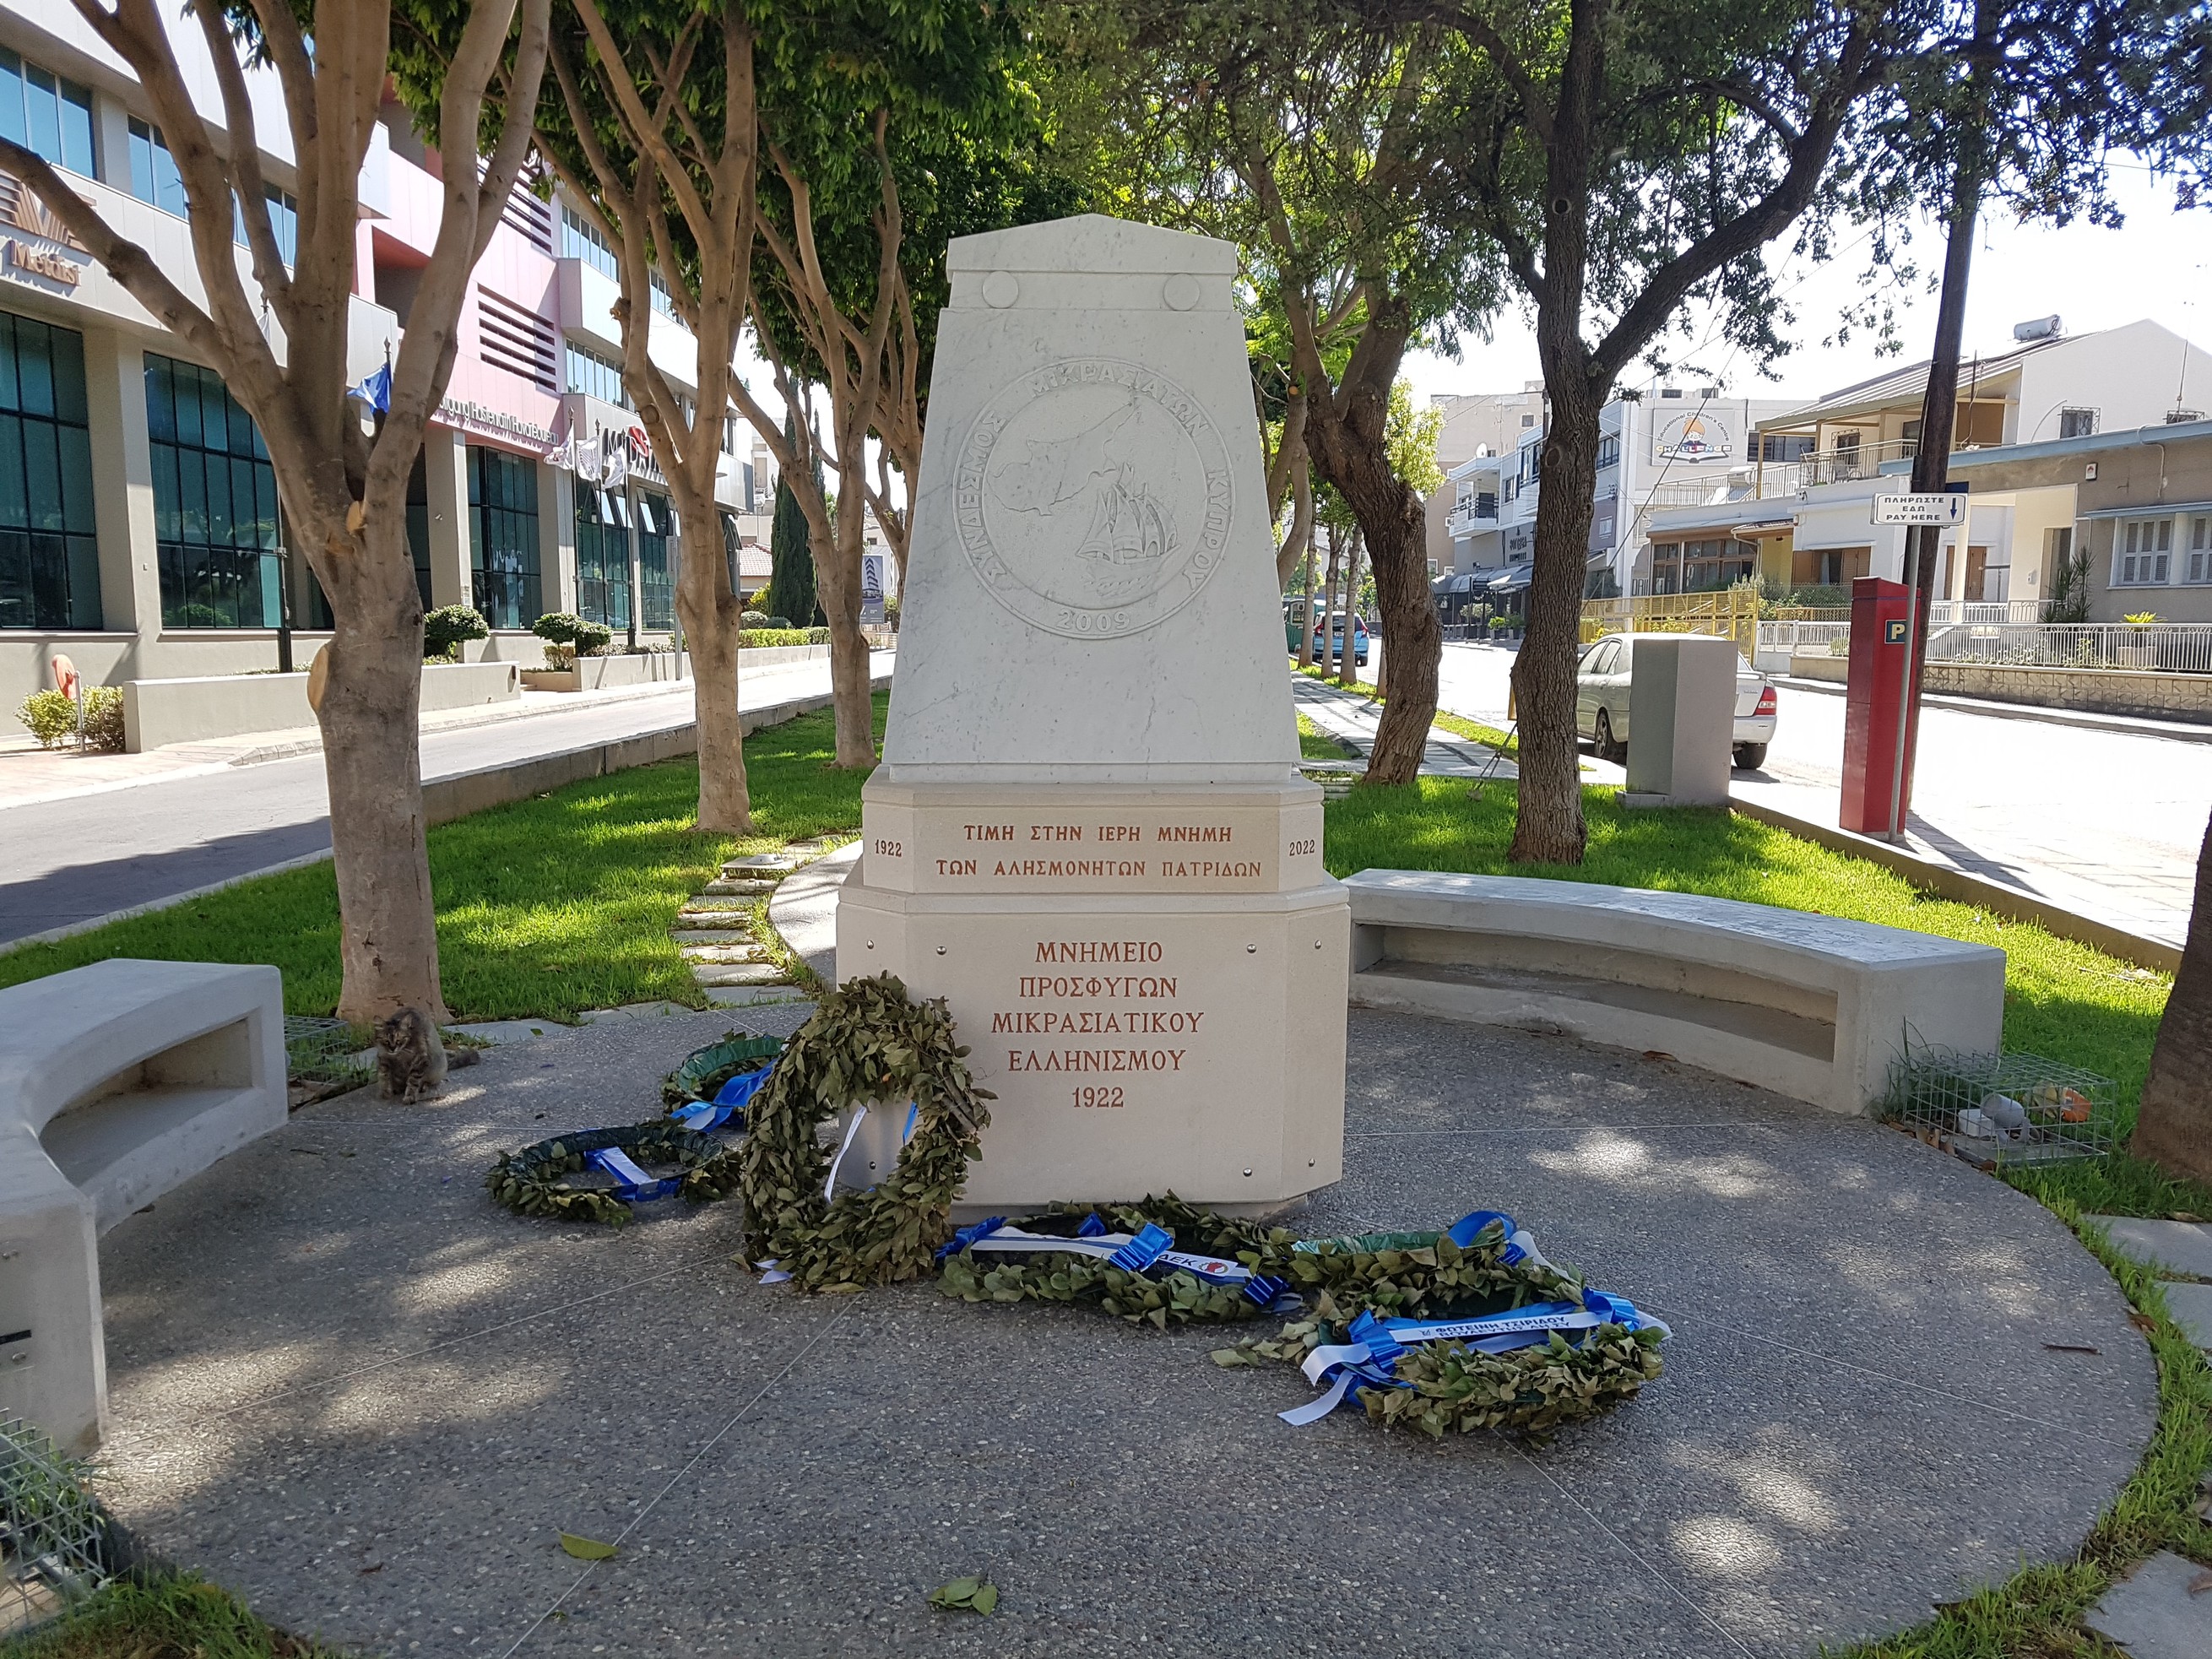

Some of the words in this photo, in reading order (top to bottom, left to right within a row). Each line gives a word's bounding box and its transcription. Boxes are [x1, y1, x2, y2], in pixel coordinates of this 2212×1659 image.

[10, 240, 81, 286] Metdist
[1024, 364, 1209, 437] ΜΙΚΡΑΣΙΑΤΩΝ
[1657, 413, 1685, 442] Educational
[1687, 412, 1717, 423] Chdren's
[1717, 422, 1729, 442] Centre
[1656, 444, 1732, 453] CHALLENGE
[959, 409, 1007, 584] ΣΥΝΔΕΣΜΟΣ
[1183, 469, 1230, 590] ΚΥΠΡΟΥ
[1056, 610, 1130, 633] 2009
[1891, 623, 1906, 639] P
[963, 825, 1014, 841] ΤΙΜΗ
[1030, 826, 1082, 841] ΣΤΗΝ
[1098, 826, 1141, 842] ΙΕΡΗ
[1158, 827, 1233, 842] ΜΝΗΜΗ
[875, 838, 903, 857] 1922
[1288, 839, 1315, 856] 2022
[936, 859, 977, 875] ΤΩΝ
[994, 860, 1146, 876] ΑΛΗΣΜΟΝΗΤΩΝ
[1162, 861, 1261, 877] ΠΑΤΡΙΔΩΝ
[1035, 941, 1163, 962] ΜΝΗΜΕΙΟ
[1019, 977, 1178, 998] ΠΡΟΣΦΥΓΩΝ
[991, 1012, 1205, 1033] ΜΙΚΡΑΣΙΑΤΙΚΟΥ
[1008, 1050, 1186, 1071] ΕΛΛΗΝΙΣΜΟΥ
[1071, 1087, 1124, 1108] 1922
[1158, 1254, 1197, 1266] ΔΕΚ
[1435, 1323, 1499, 1333] ΦΩΤΕΙΝΗ
[1502, 1316, 1565, 1327] ΤΣΙΡΙΔΟΥ
